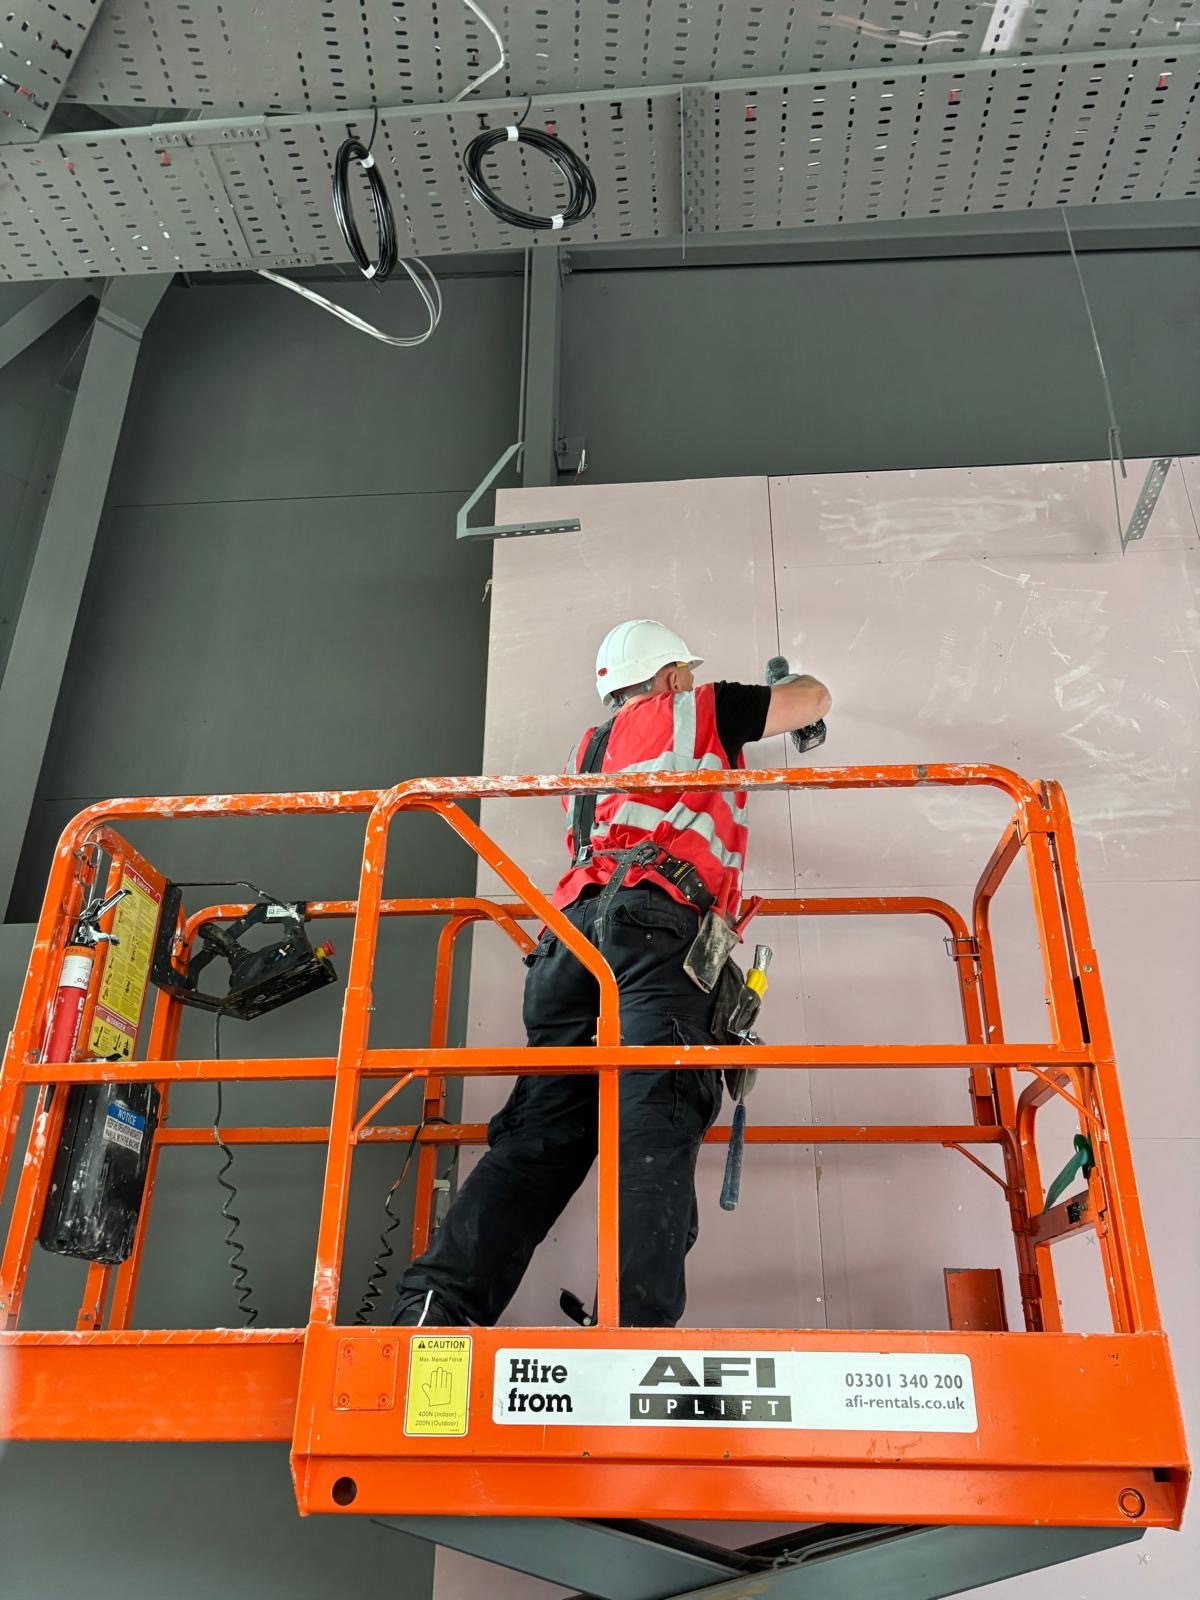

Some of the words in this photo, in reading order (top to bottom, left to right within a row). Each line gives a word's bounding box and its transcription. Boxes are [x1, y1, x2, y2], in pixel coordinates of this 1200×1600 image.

[117, 1109, 137, 1126] NOTICE
[427, 1340, 465, 1349] CAUTION
[509, 1358, 568, 1384] Hire
[638, 1356, 776, 1388] AFI
[845, 1372, 892, 1388] 03301
[899, 1373, 928, 1389] 340
[934, 1374, 963, 1389] 200
[508, 1387, 573, 1413] from
[638, 1398, 779, 1416] UPLIFT
[845, 1394, 966, 1410] afi-rentals.co.uk
